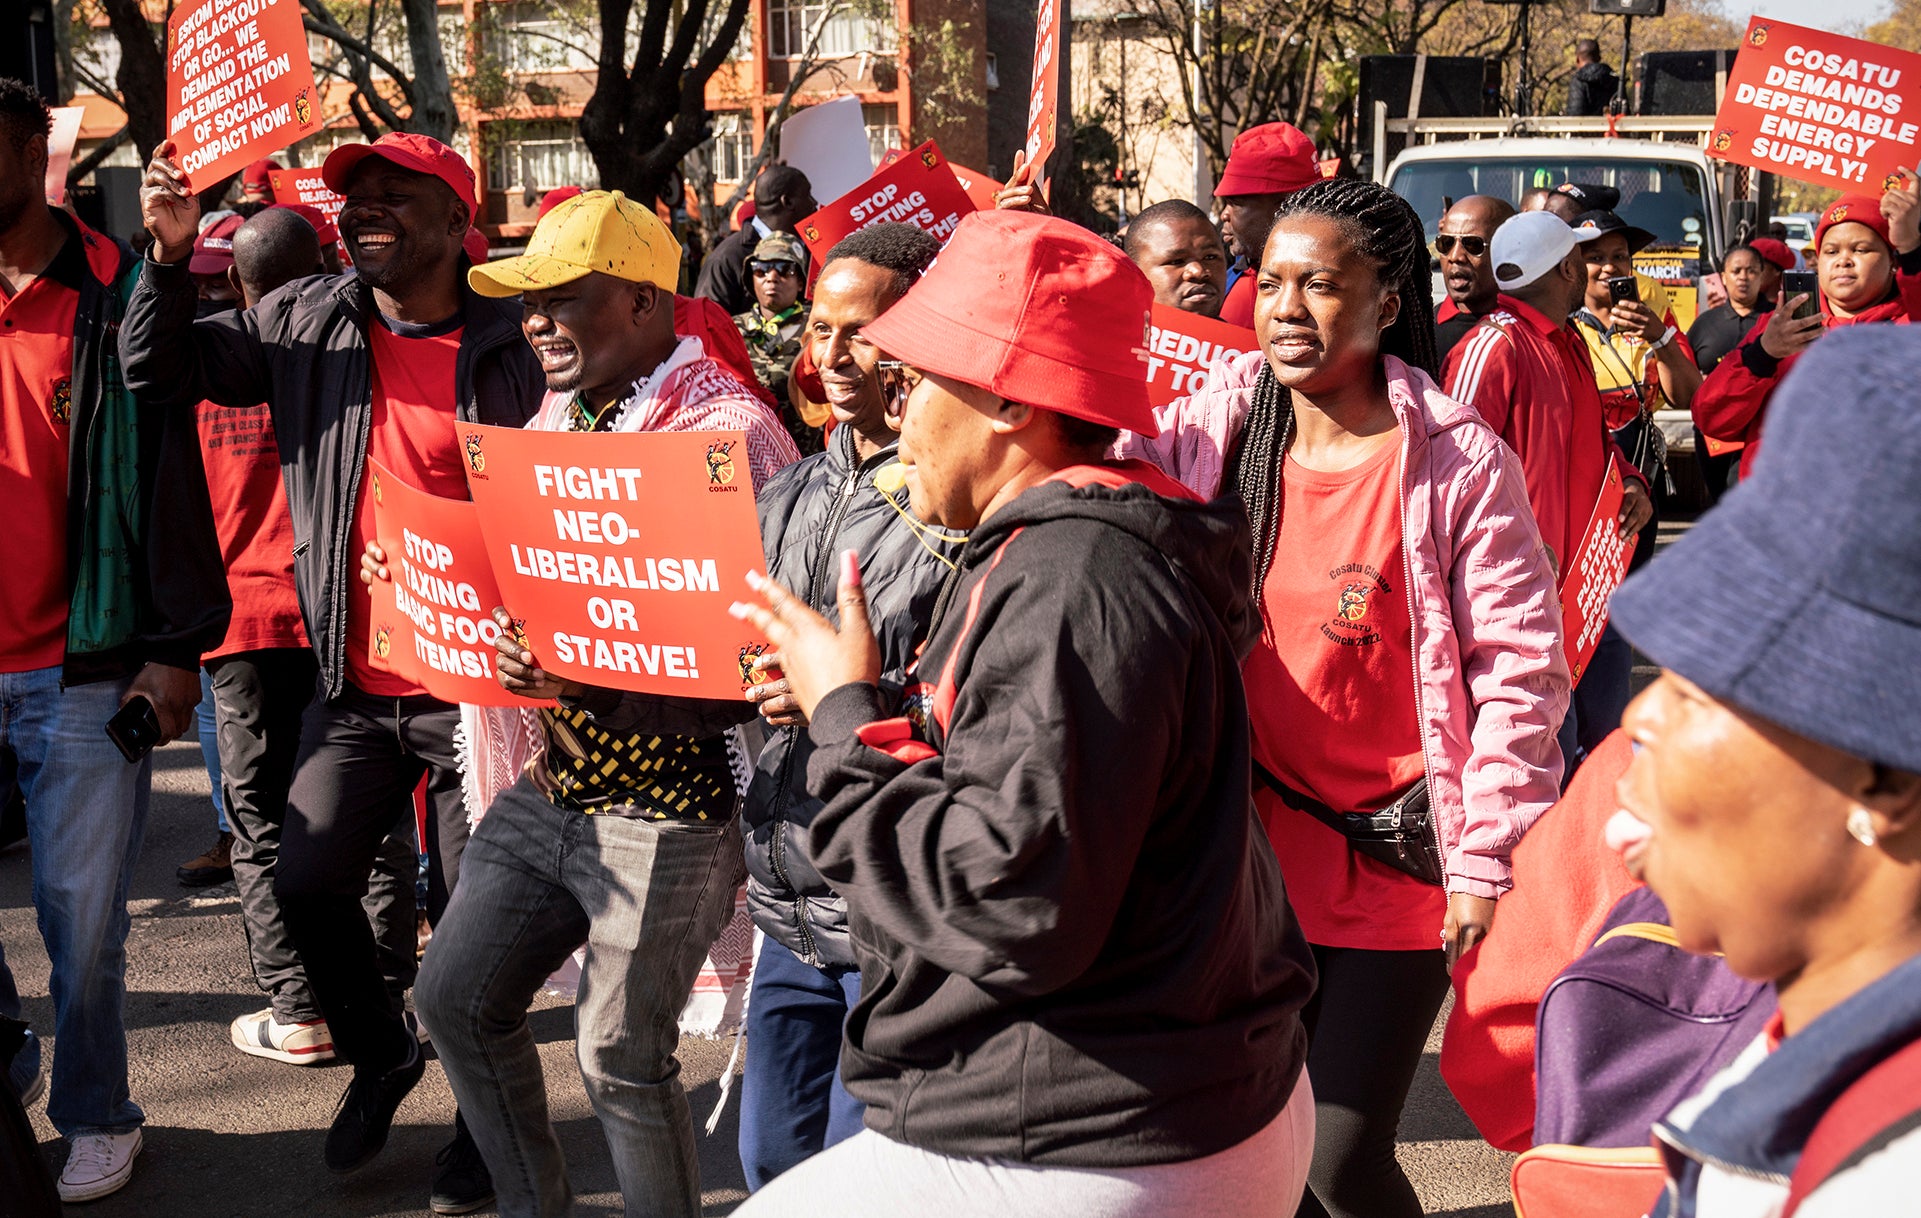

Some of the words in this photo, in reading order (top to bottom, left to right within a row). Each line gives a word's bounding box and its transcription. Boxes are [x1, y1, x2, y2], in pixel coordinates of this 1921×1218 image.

[177, 1, 213, 45] ESKOM
[172, 37, 194, 72] STOP
[181, 58, 236, 106] DEMAND
[237, 40, 269, 71] THE
[183, 56, 200, 80] OR
[202, 42, 234, 68] GO...
[234, 20, 260, 48] WE
[1784, 45, 1901, 88] COSATU
[170, 53, 291, 136] IMPLEMENTATION
[1735, 83, 1920, 145] DEPENDABLE
[1764, 65, 1903, 115] DEMANDS
[182, 126, 249, 175] COMPACT
[250, 102, 292, 145] NOW!
[193, 117, 214, 143] OF
[214, 92, 268, 129] SOCIAL
[1759, 113, 1876, 158] ENERGY
[295, 177, 326, 191] COSA
[1751, 137, 1869, 183] SUPPLY!
[849, 183, 898, 223] STOP
[1637, 267, 1681, 279] MARCH
[533, 464, 642, 501] FIGHT
[403, 527, 454, 572] STOP
[553, 509, 640, 546] NEO-
[1580, 518, 1603, 576] STOP
[401, 557, 481, 612] TAXING
[510, 544, 720, 592] LIBERALISM
[1329, 563, 1363, 580] Cosatu
[1364, 565, 1392, 594] Cluster
[1577, 517, 1614, 608] PUTTING
[1581, 532, 1617, 621] PROFITS
[395, 581, 437, 636] BASIC
[439, 612, 504, 647] FOO
[587, 596, 640, 632] OR
[1320, 623, 1354, 646] Launch
[1332, 619, 1372, 632] COSATU
[1576, 575, 1613, 653] BEFORE
[413, 629, 493, 679] ITEMS!
[553, 631, 700, 679] STARVE!
